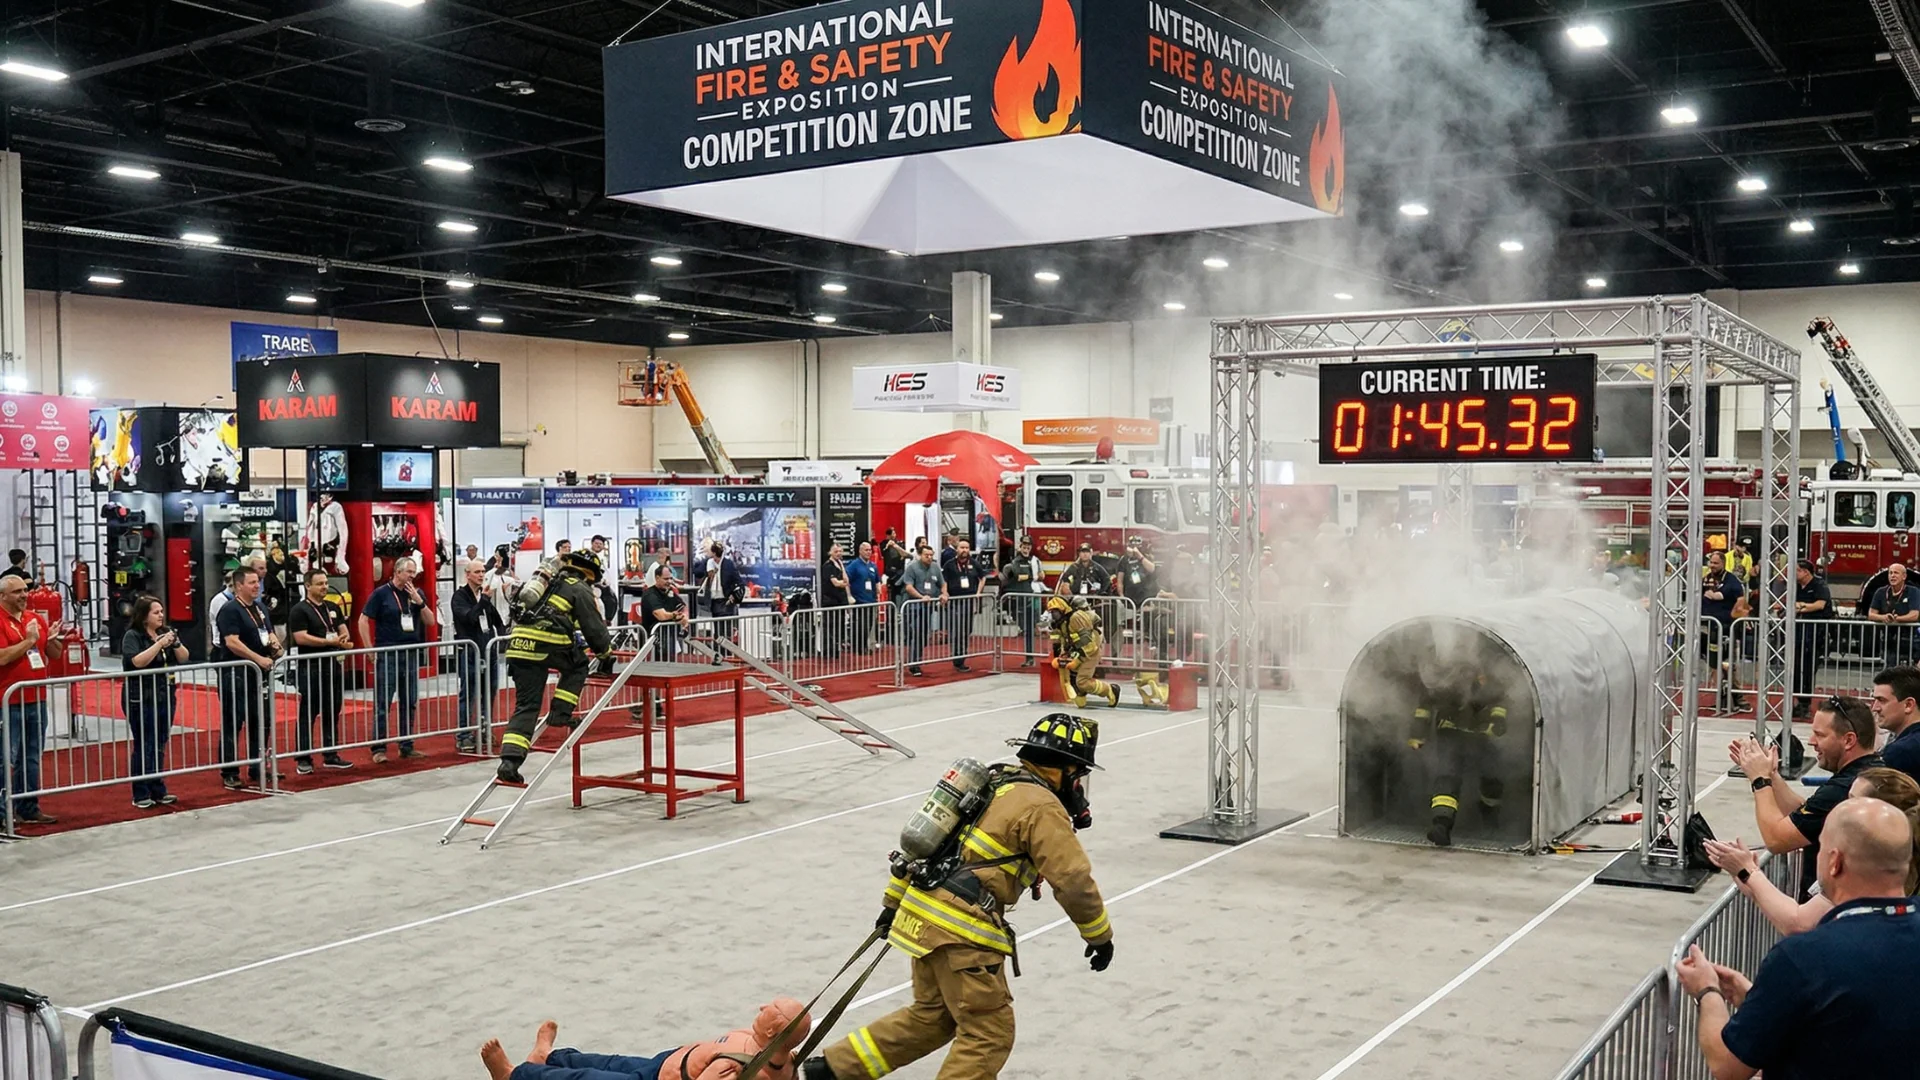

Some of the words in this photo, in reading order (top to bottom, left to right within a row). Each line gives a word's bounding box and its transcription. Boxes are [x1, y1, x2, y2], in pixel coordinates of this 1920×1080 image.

[696, 0, 954, 70] INTERNATIONAL
[1149, 1, 1295, 90] INTERNATIONAL
[697, 65, 767, 104] FIRE
[778, 60, 800, 90] &
[810, 32, 953, 84] SAFETY
[1149, 35, 1196, 84] FIRE
[1202, 59, 1215, 91] &
[1221, 68, 1293, 121] SAFETY
[742, 77, 898, 121] EXPOSITION
[1180, 86, 1268, 136] EXPOSITION
[683, 110, 878, 171] COMPETITION
[888, 95, 972, 140] ZONE
[1141, 99, 1258, 172] COMPETITION
[1262, 144, 1301, 187] ZONE
[258, 394, 338, 421] KARAM
[1360, 367, 1473, 395] CURRENT
[1479, 364, 1546, 391] TIME:
[390, 396, 478, 423] KARAM
[1332, 395, 1578, 454] 01:45.32
[706, 492, 796, 502] PRI-SAFETY
